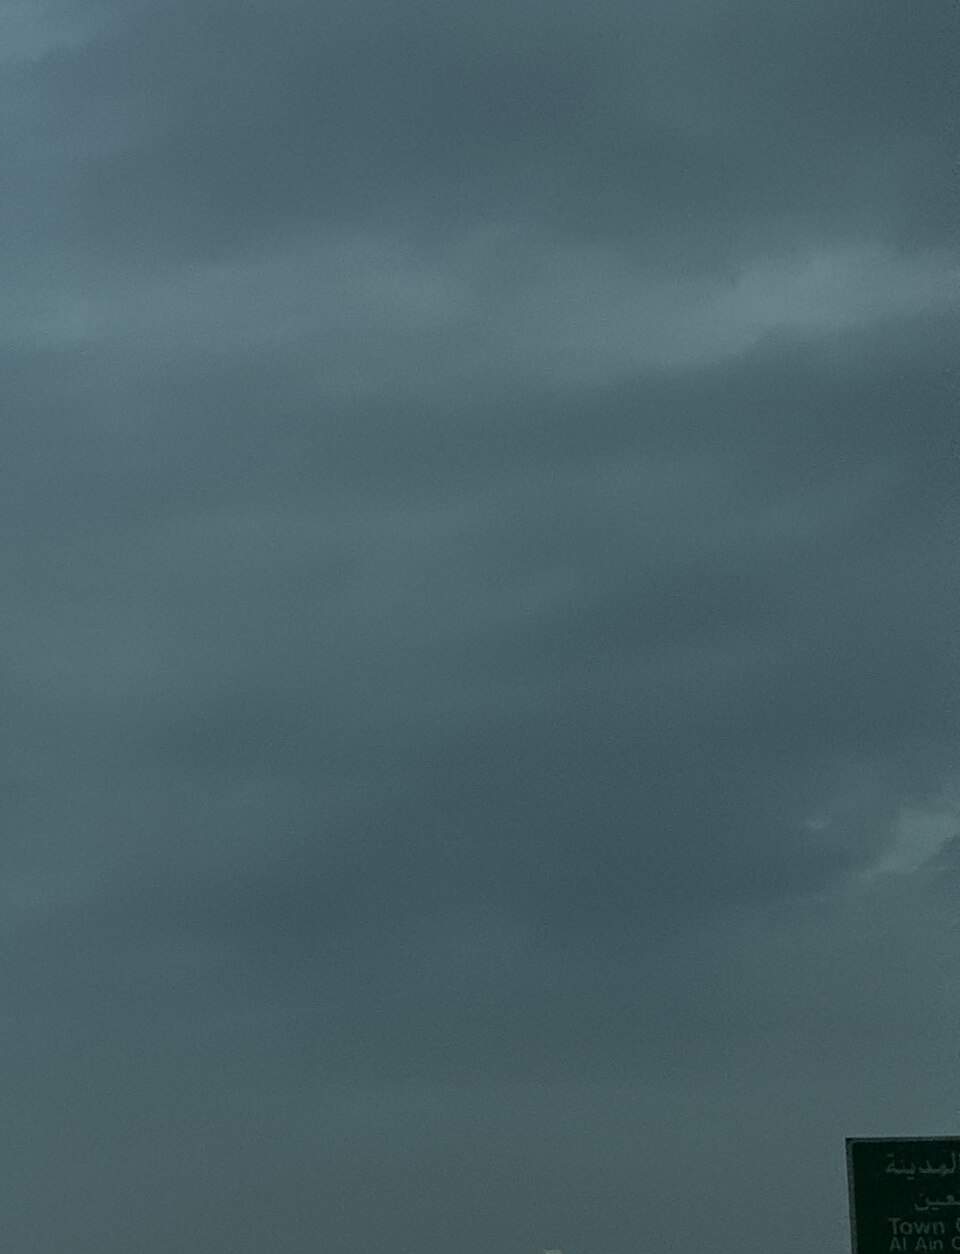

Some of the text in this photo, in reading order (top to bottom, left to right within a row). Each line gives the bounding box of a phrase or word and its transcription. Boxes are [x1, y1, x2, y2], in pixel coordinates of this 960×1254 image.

[887, 1217, 945, 1235] Town
[889, 1236, 907, 1251] Al
[915, 1236, 944, 1251] Ain
